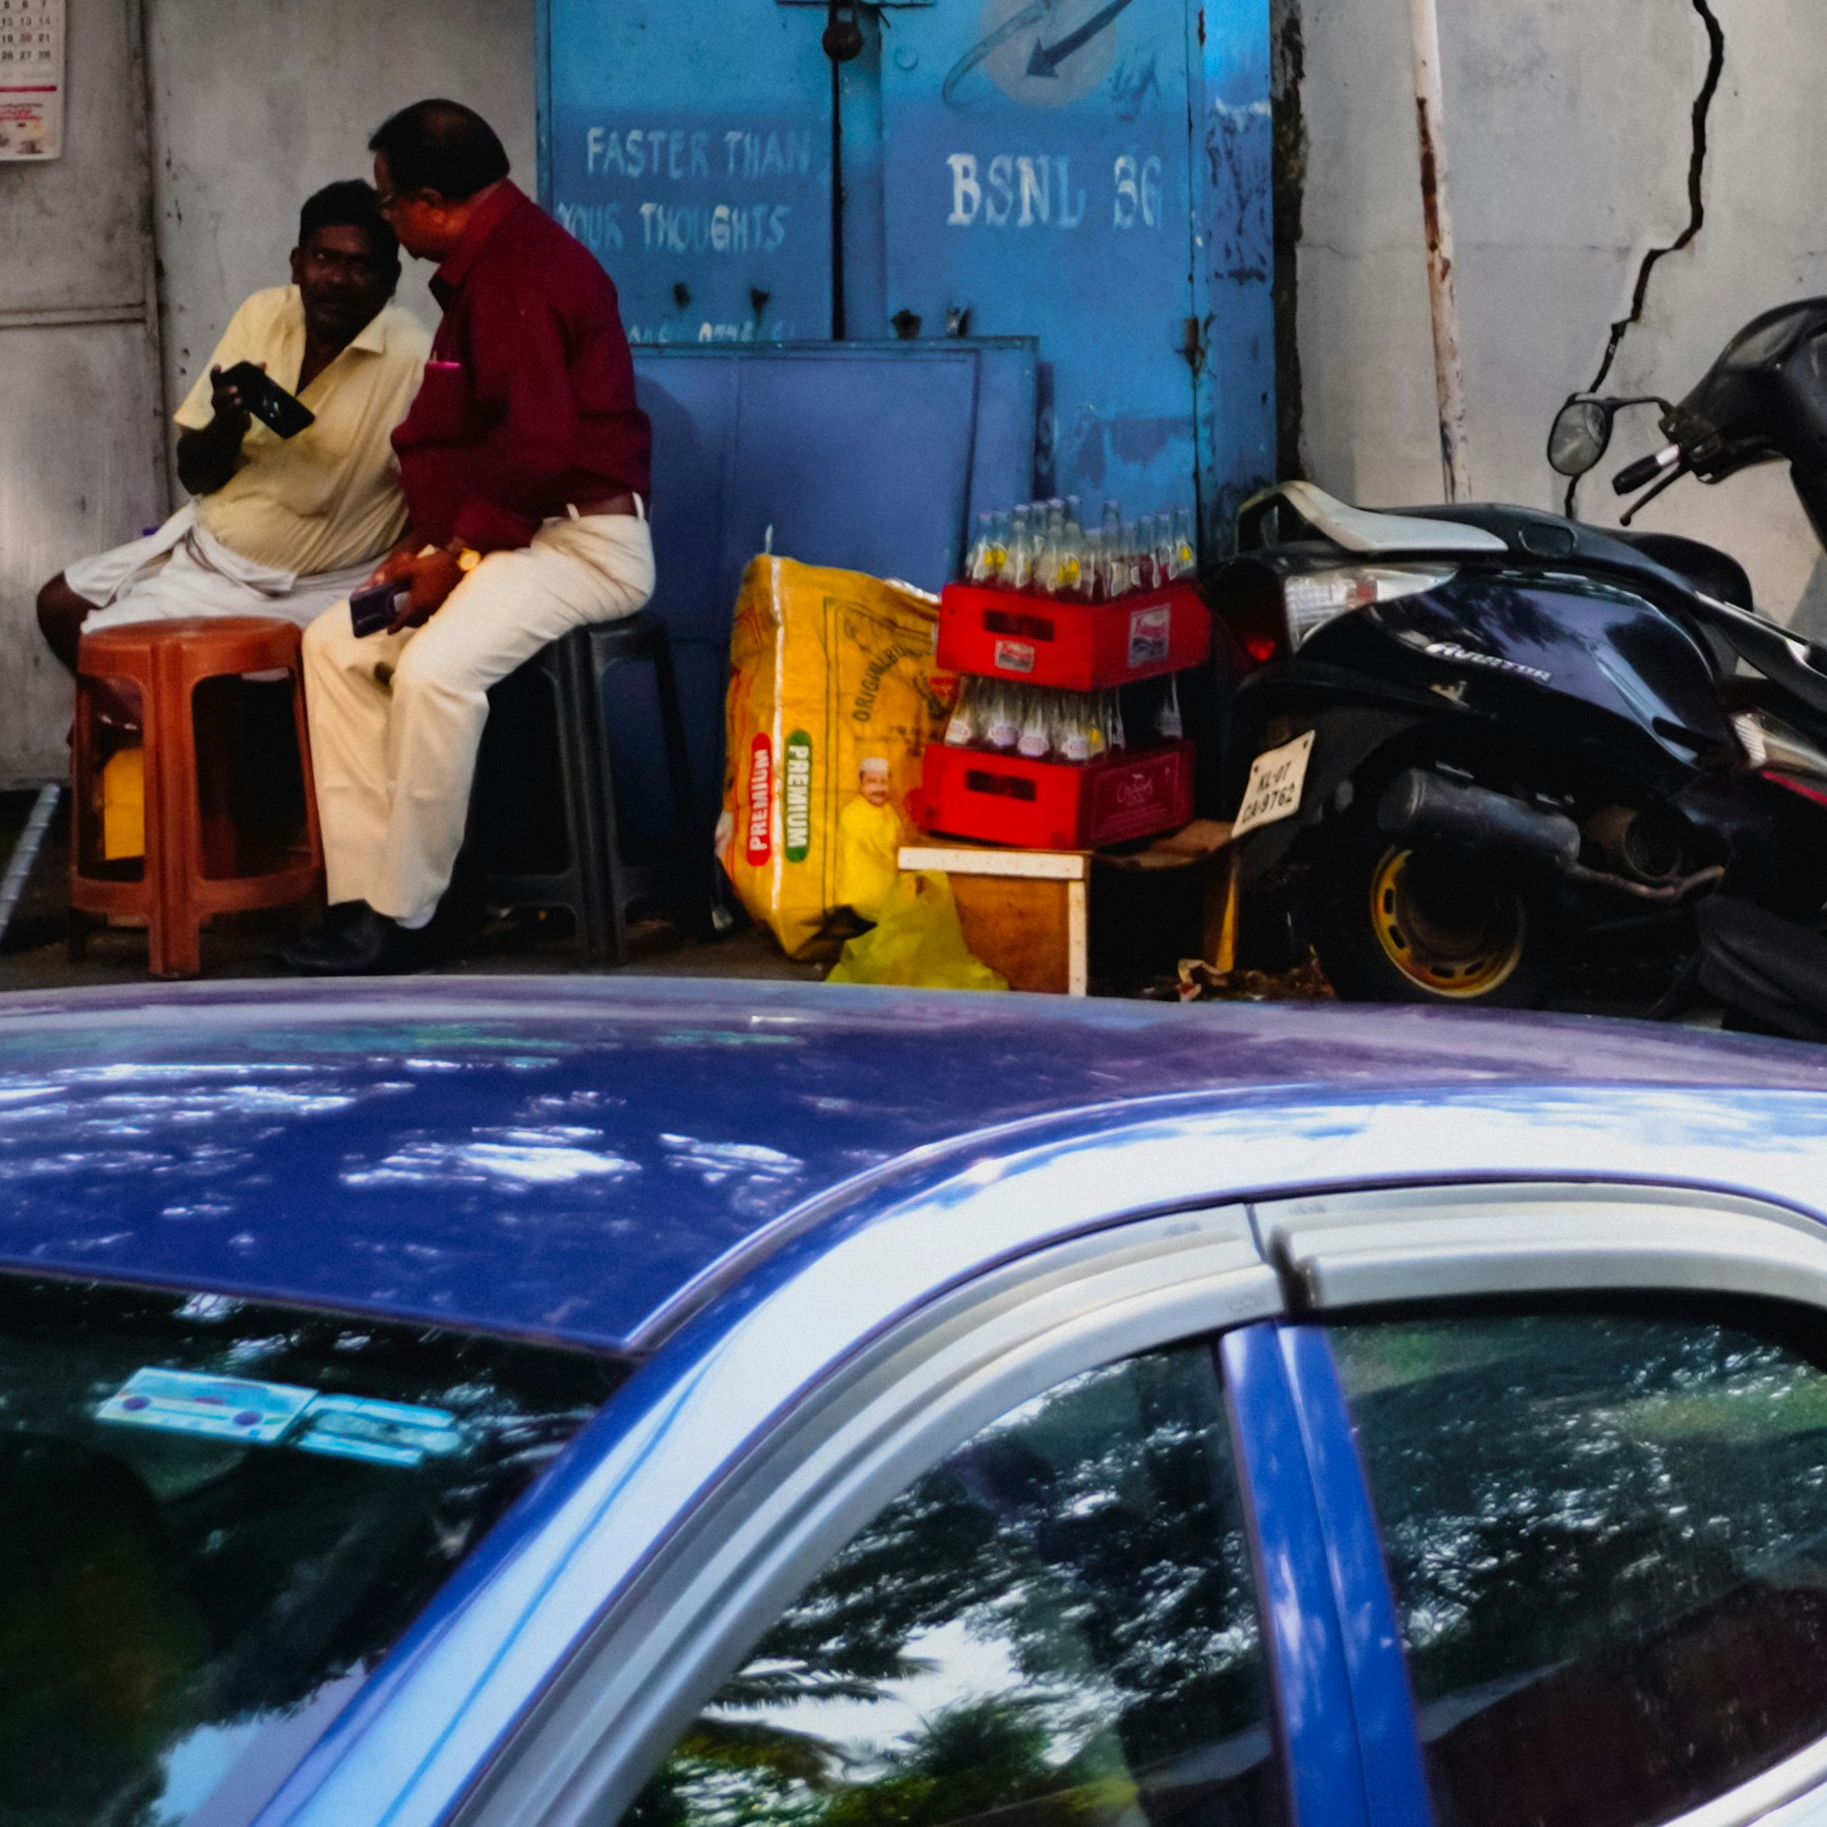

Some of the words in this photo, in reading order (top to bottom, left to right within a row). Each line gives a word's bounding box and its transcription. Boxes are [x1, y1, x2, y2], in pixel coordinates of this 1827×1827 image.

[587, 127, 709, 180] FASTER
[725, 131, 810, 178] THAN
[946, 153, 1086, 228] BSNL
[640, 201, 790, 253] THOUGHTS
[749, 749, 770, 852] PREMIUM
[786, 745, 810, 848] PREMIUM
